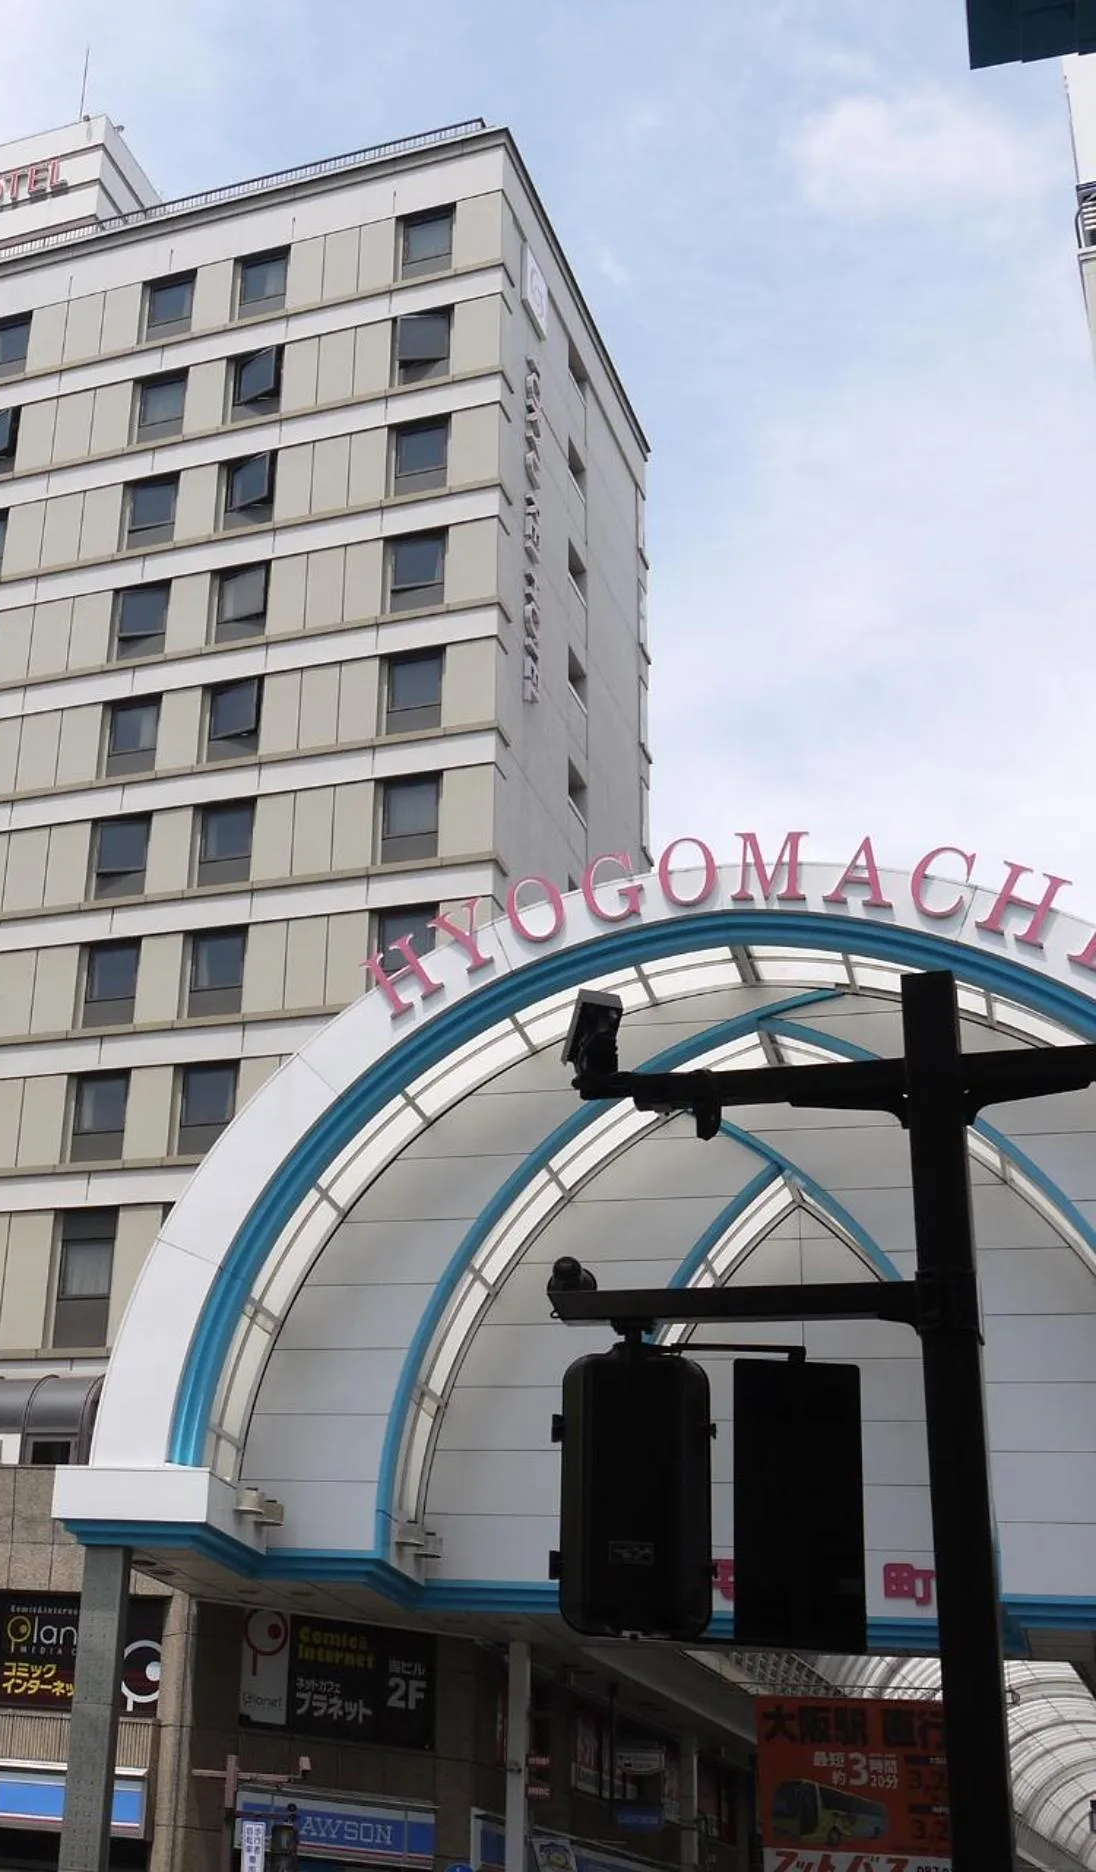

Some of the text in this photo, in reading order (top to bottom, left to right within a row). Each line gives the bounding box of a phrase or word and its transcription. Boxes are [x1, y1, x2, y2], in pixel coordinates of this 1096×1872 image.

[3, 1661, 58, 1679] コミック
[2, 1678, 75, 1697] インターネッ
[386, 1677, 428, 1711] 2F
[849, 1752, 869, 1787] 3
[299, 1815, 393, 1846] AWSON
